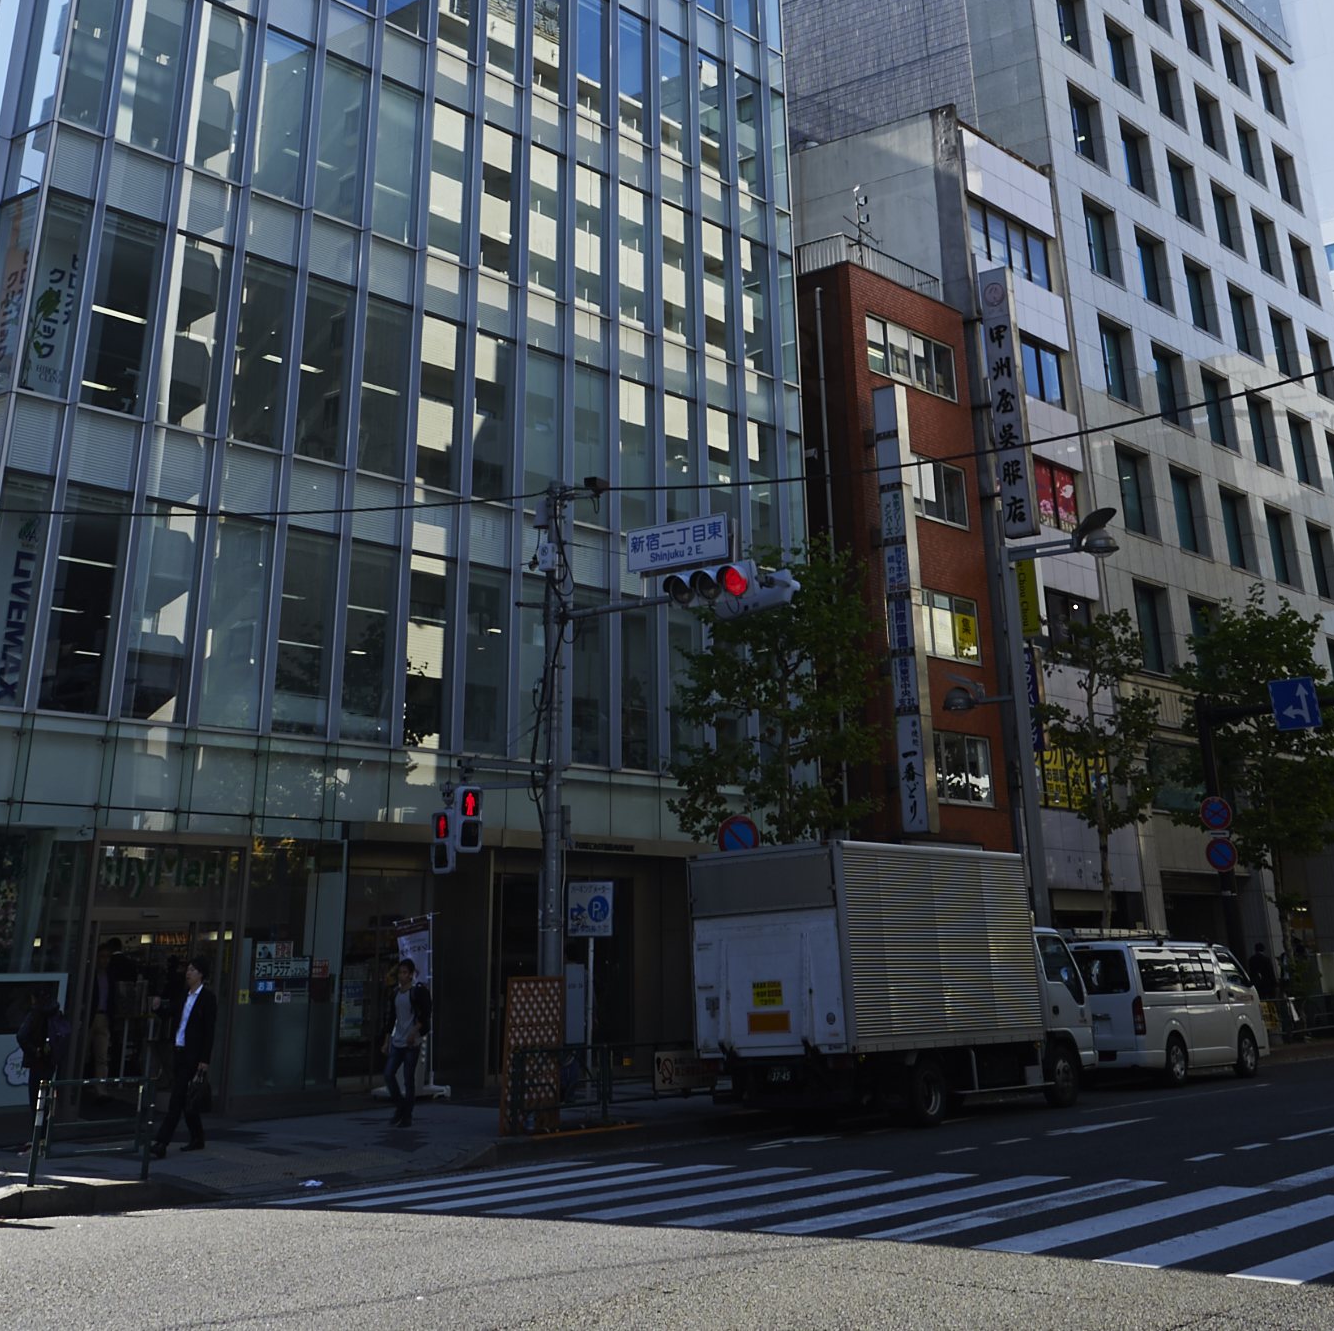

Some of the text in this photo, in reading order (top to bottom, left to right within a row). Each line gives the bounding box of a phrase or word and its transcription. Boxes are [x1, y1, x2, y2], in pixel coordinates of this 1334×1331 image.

[630, 521, 722, 554] 新宿二丁目東
[650, 549, 685, 562] Shinjuku
[688, 547, 693, 556] 2
[902, 750, 923, 823] 一番どり
